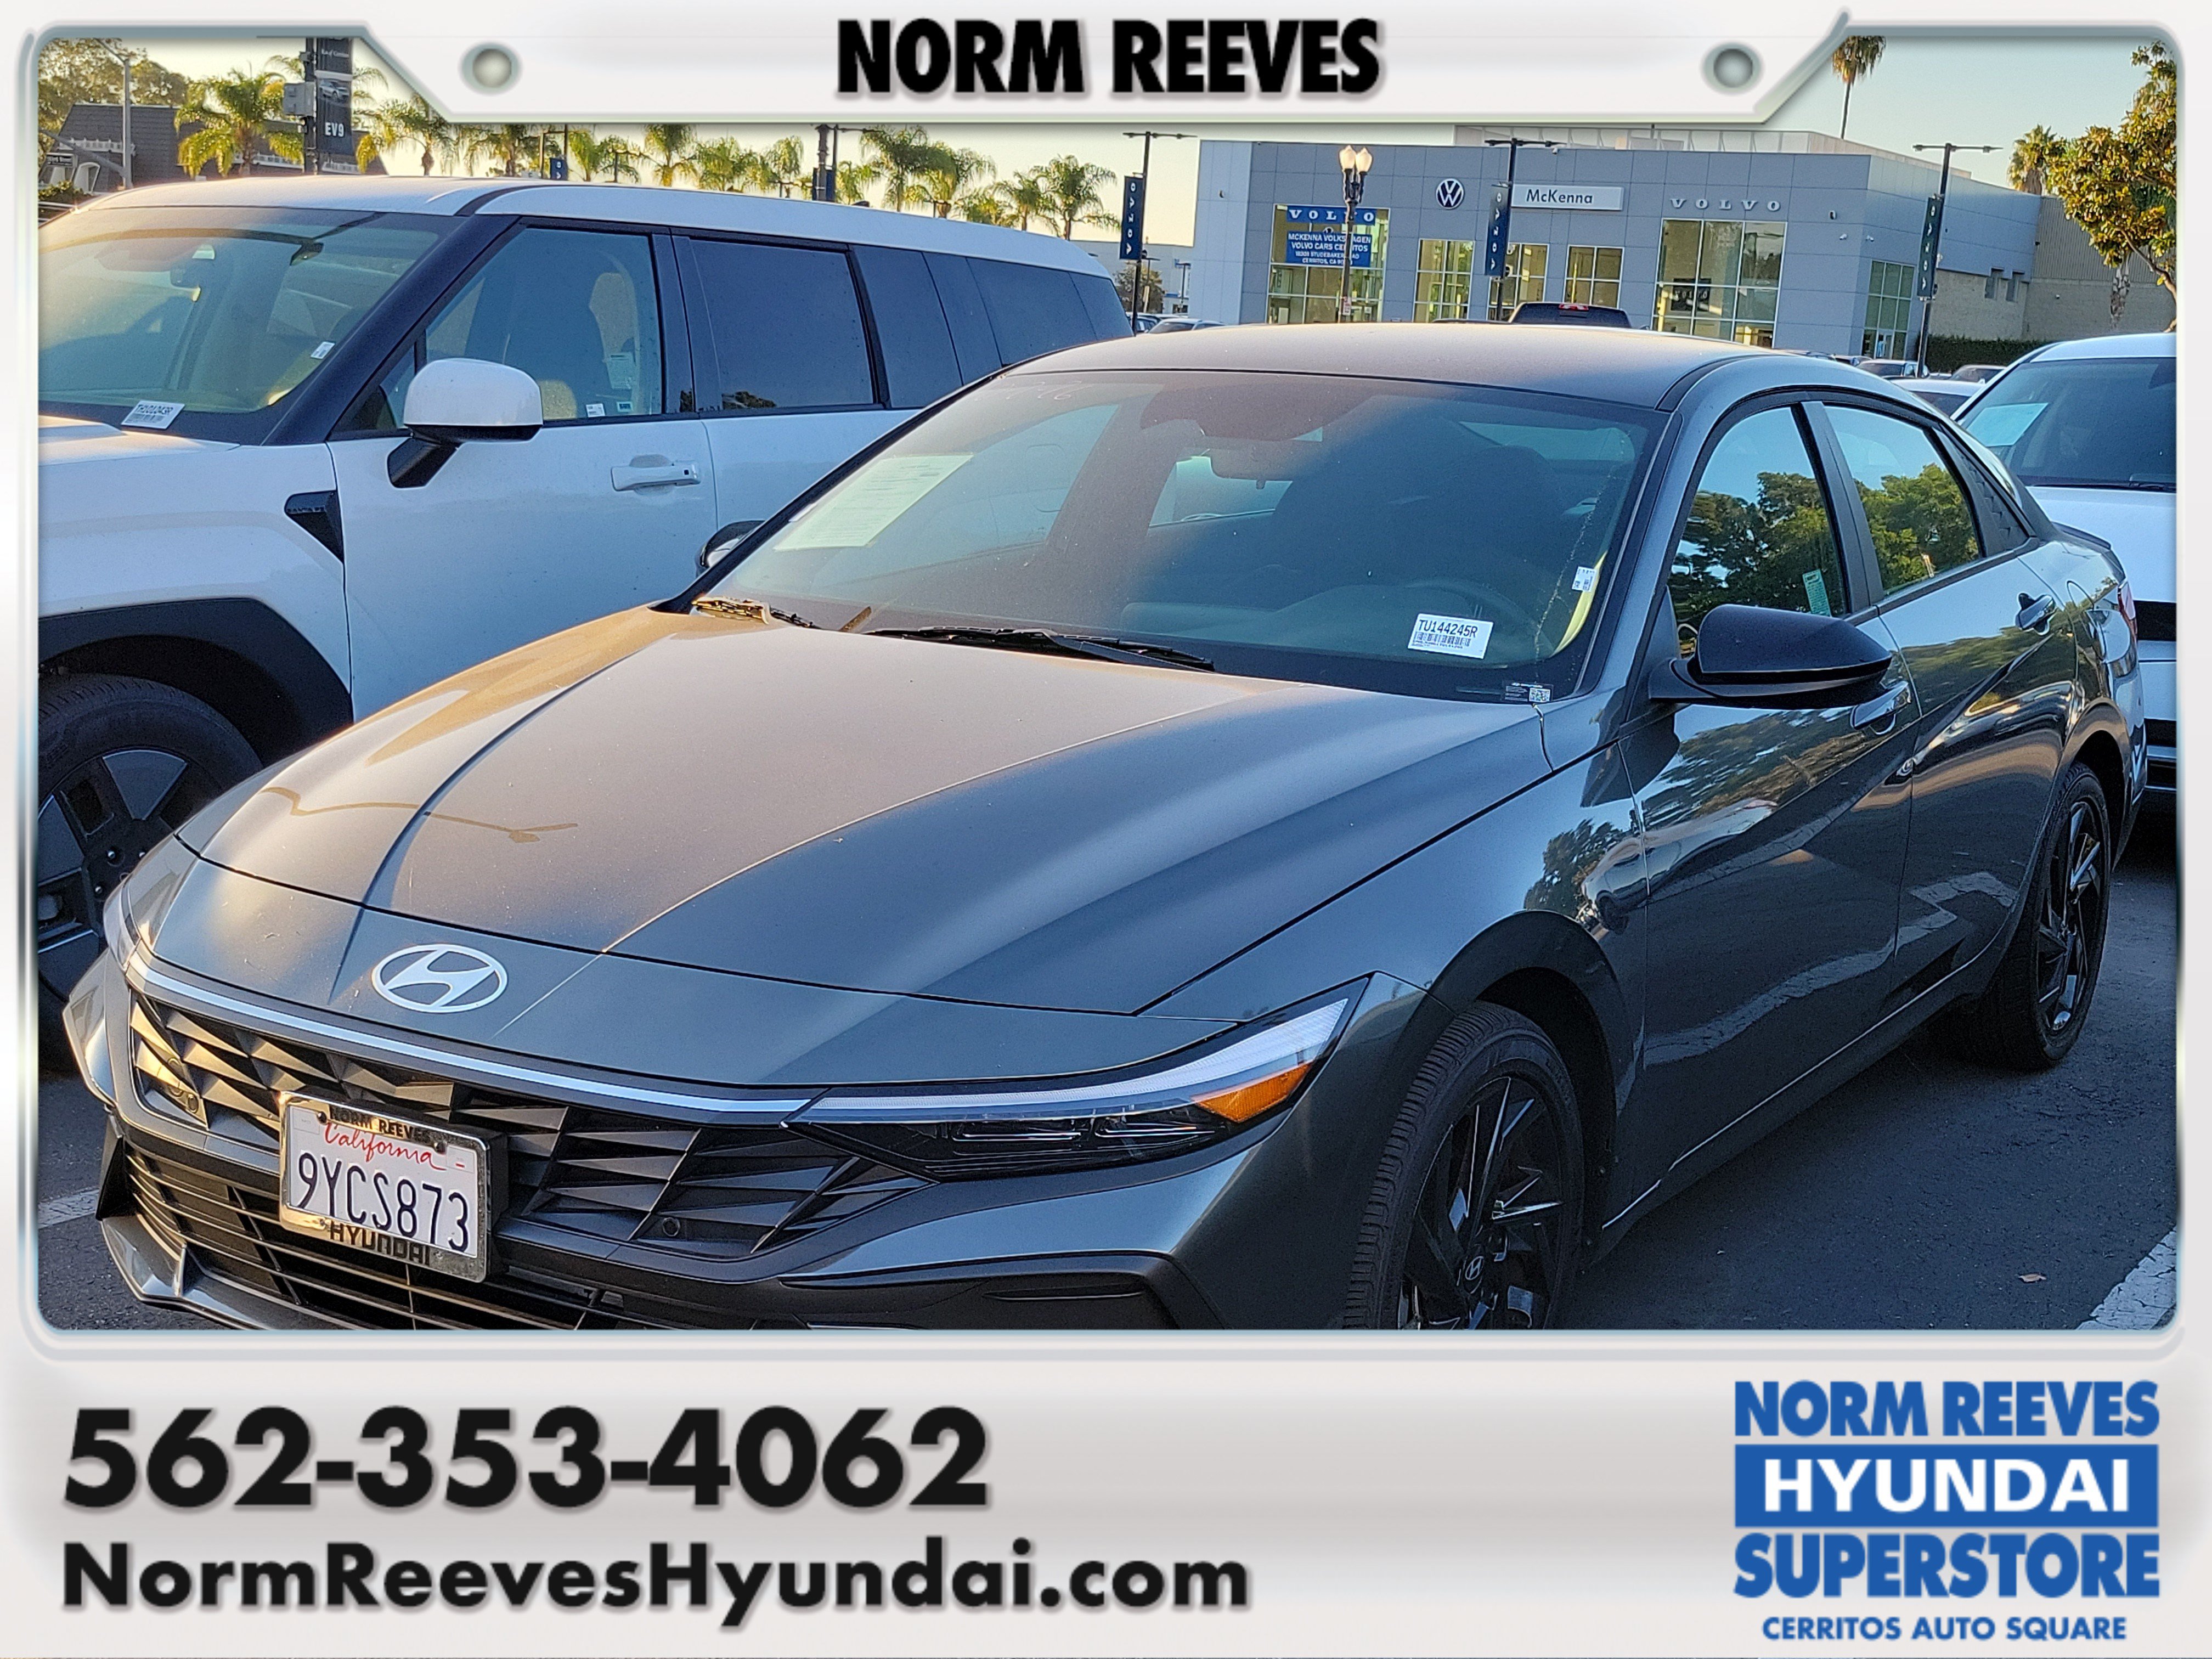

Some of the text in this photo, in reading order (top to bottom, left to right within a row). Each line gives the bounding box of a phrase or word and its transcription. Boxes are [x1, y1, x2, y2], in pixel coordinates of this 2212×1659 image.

[325, 122, 344, 137] EV9
[1526, 189, 1593, 204] McKenna
[1671, 198, 1781, 212] VOLVO
[1126, 182, 1136, 255] VOLVO
[1289, 209, 1375, 222] VOLO
[1288, 233, 1371, 244] MCKENNA VOLKSAGEN
[1490, 192, 1502, 270] VOLVO
[1291, 241, 1313, 250] VOLVO
[1334, 243, 1368, 252] CEITOS
[1922, 205, 1936, 290] VOLVO
[1418, 619, 1478, 638] TU144245R
[324, 1123, 448, 1171] California
[298, 1152, 469, 1253] 9YCS873
[329, 1221, 430, 1266] HYUNDAI
